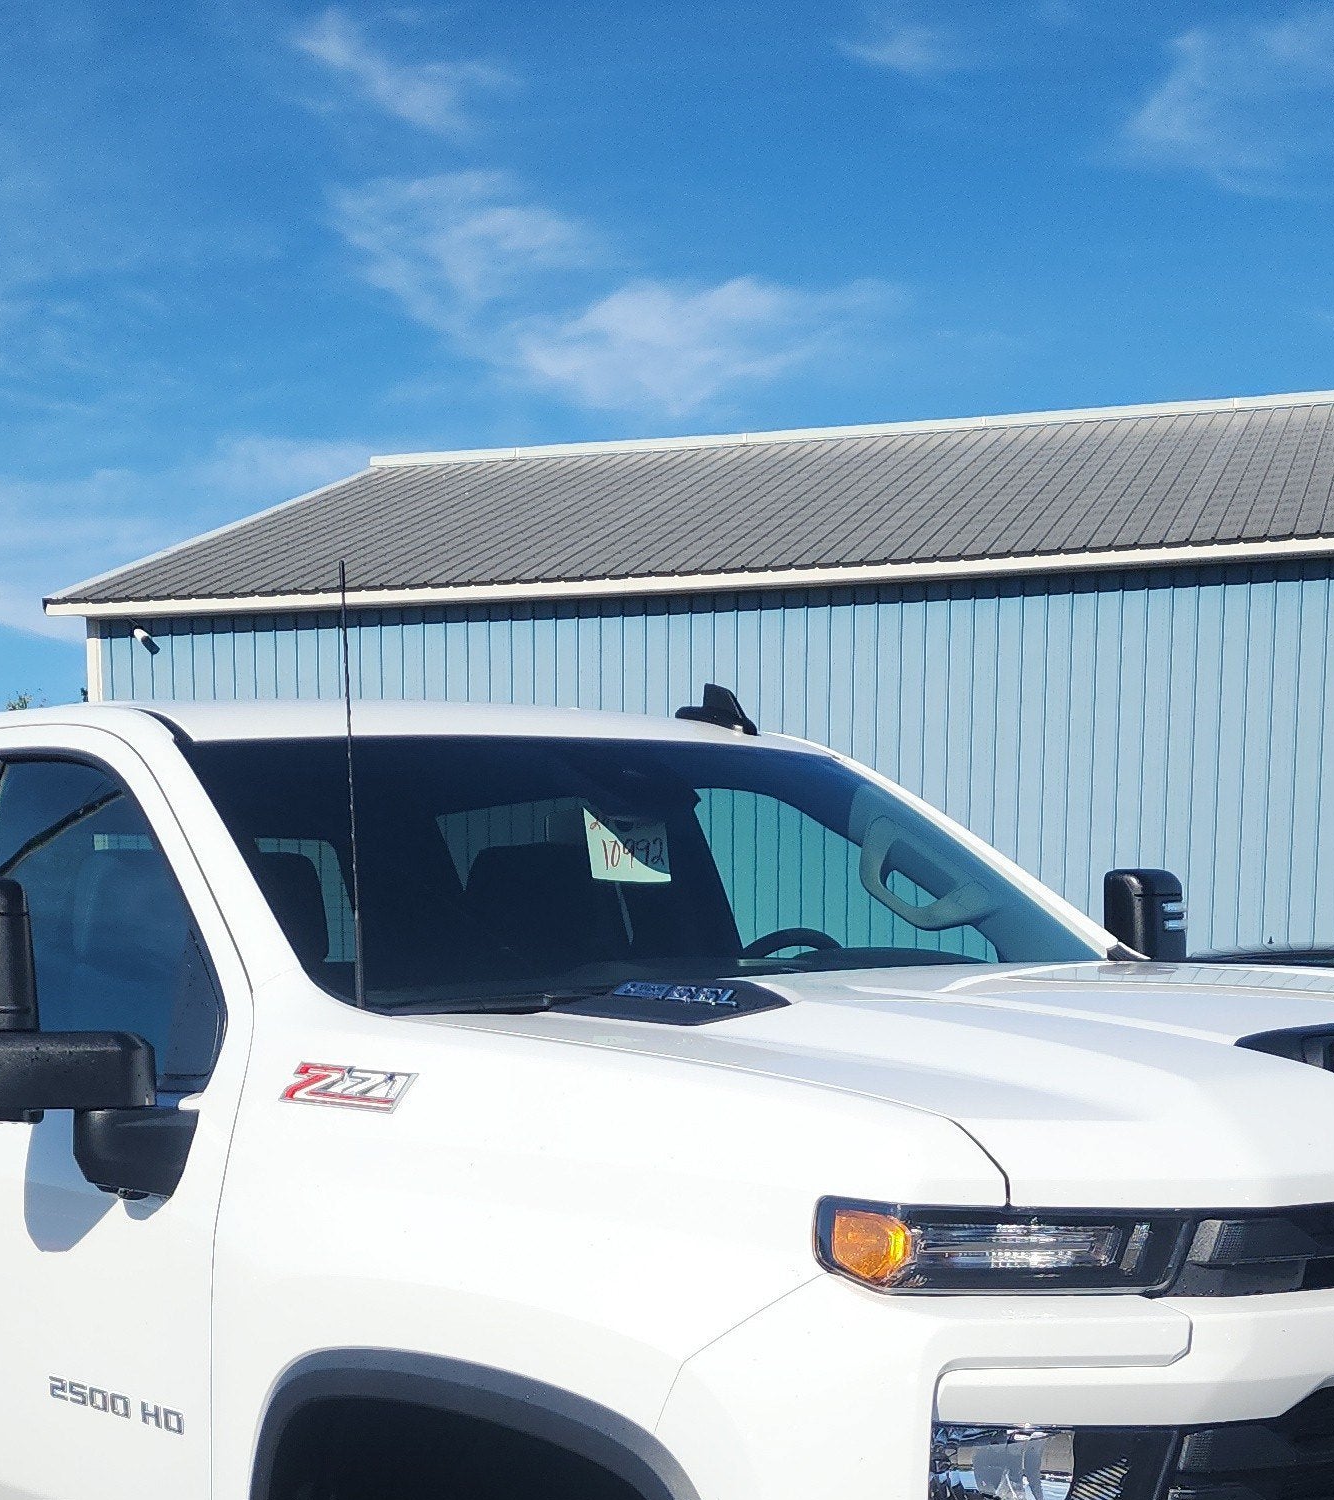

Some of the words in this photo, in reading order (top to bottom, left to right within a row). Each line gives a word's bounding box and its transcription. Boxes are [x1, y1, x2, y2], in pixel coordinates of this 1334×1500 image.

[279, 1061, 419, 1114] Z71
[48, 1375, 131, 1420] 2500
[140, 1400, 184, 1435] HD
